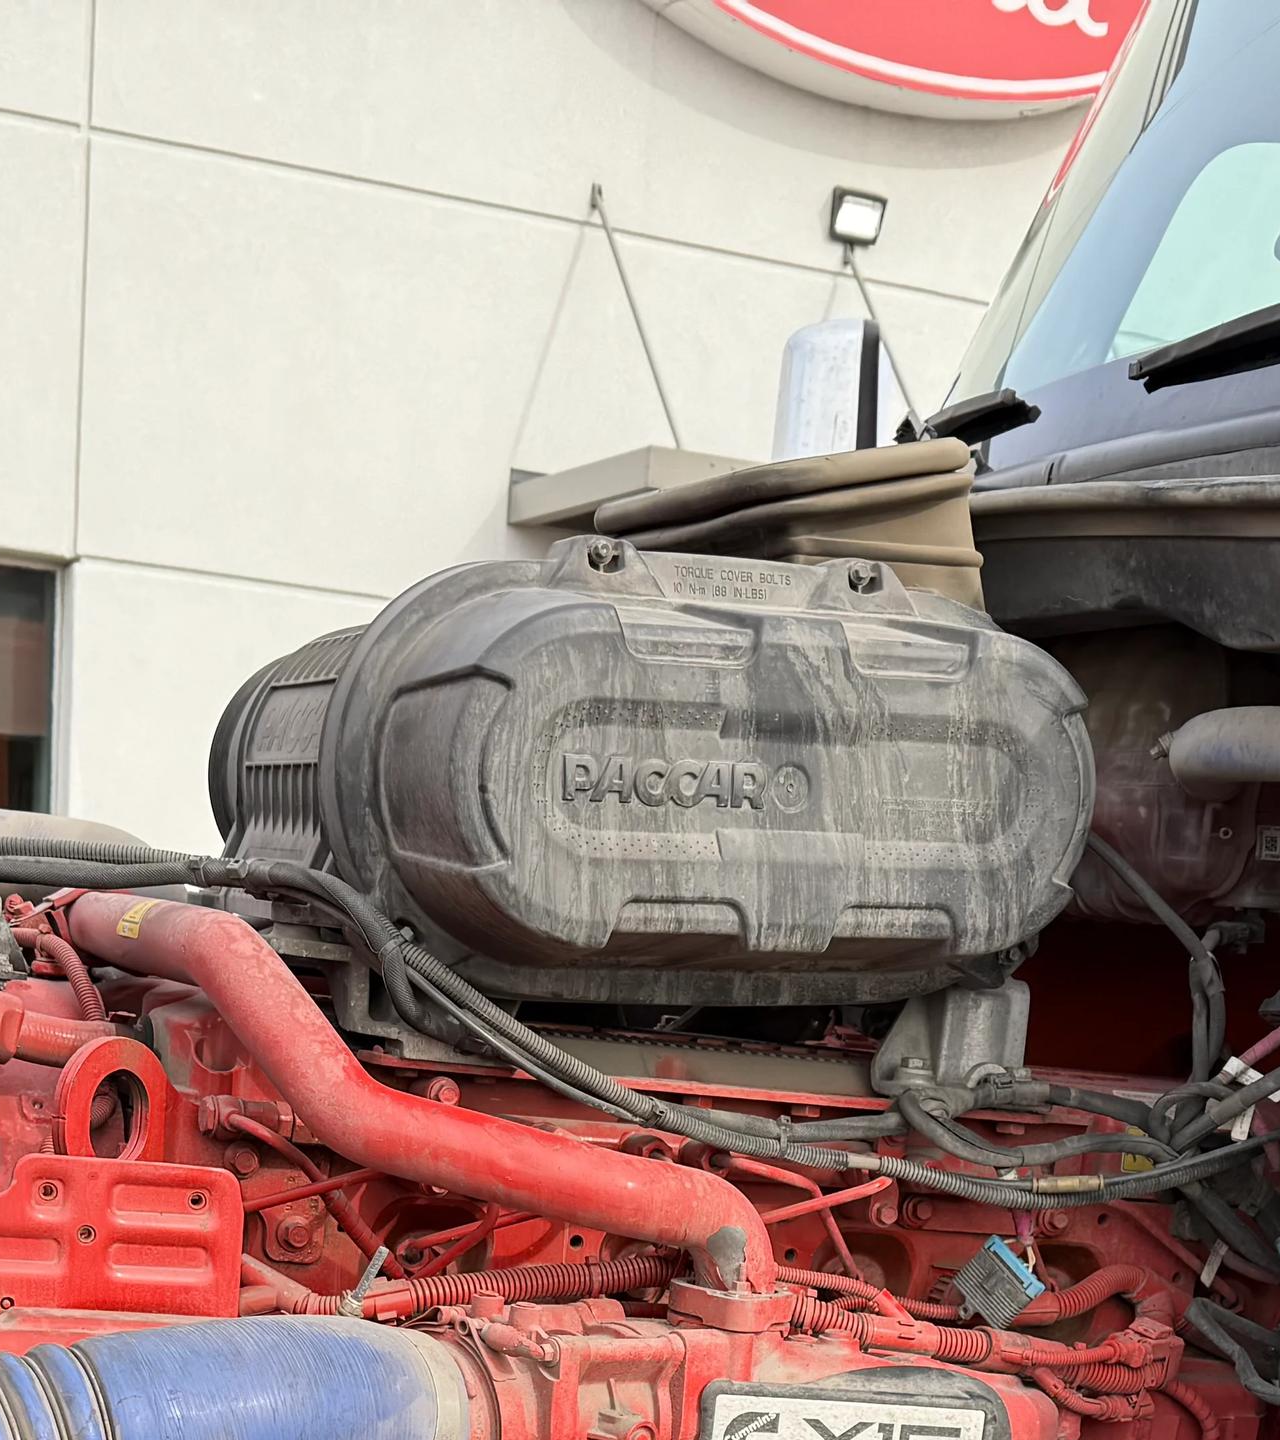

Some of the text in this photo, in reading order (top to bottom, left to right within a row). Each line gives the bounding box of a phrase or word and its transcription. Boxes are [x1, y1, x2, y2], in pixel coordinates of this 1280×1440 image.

[674, 565, 792, 586] TORQUE COVER BOLTS
[673, 582, 682, 594] 10
[561, 753, 768, 810] PACCAR
